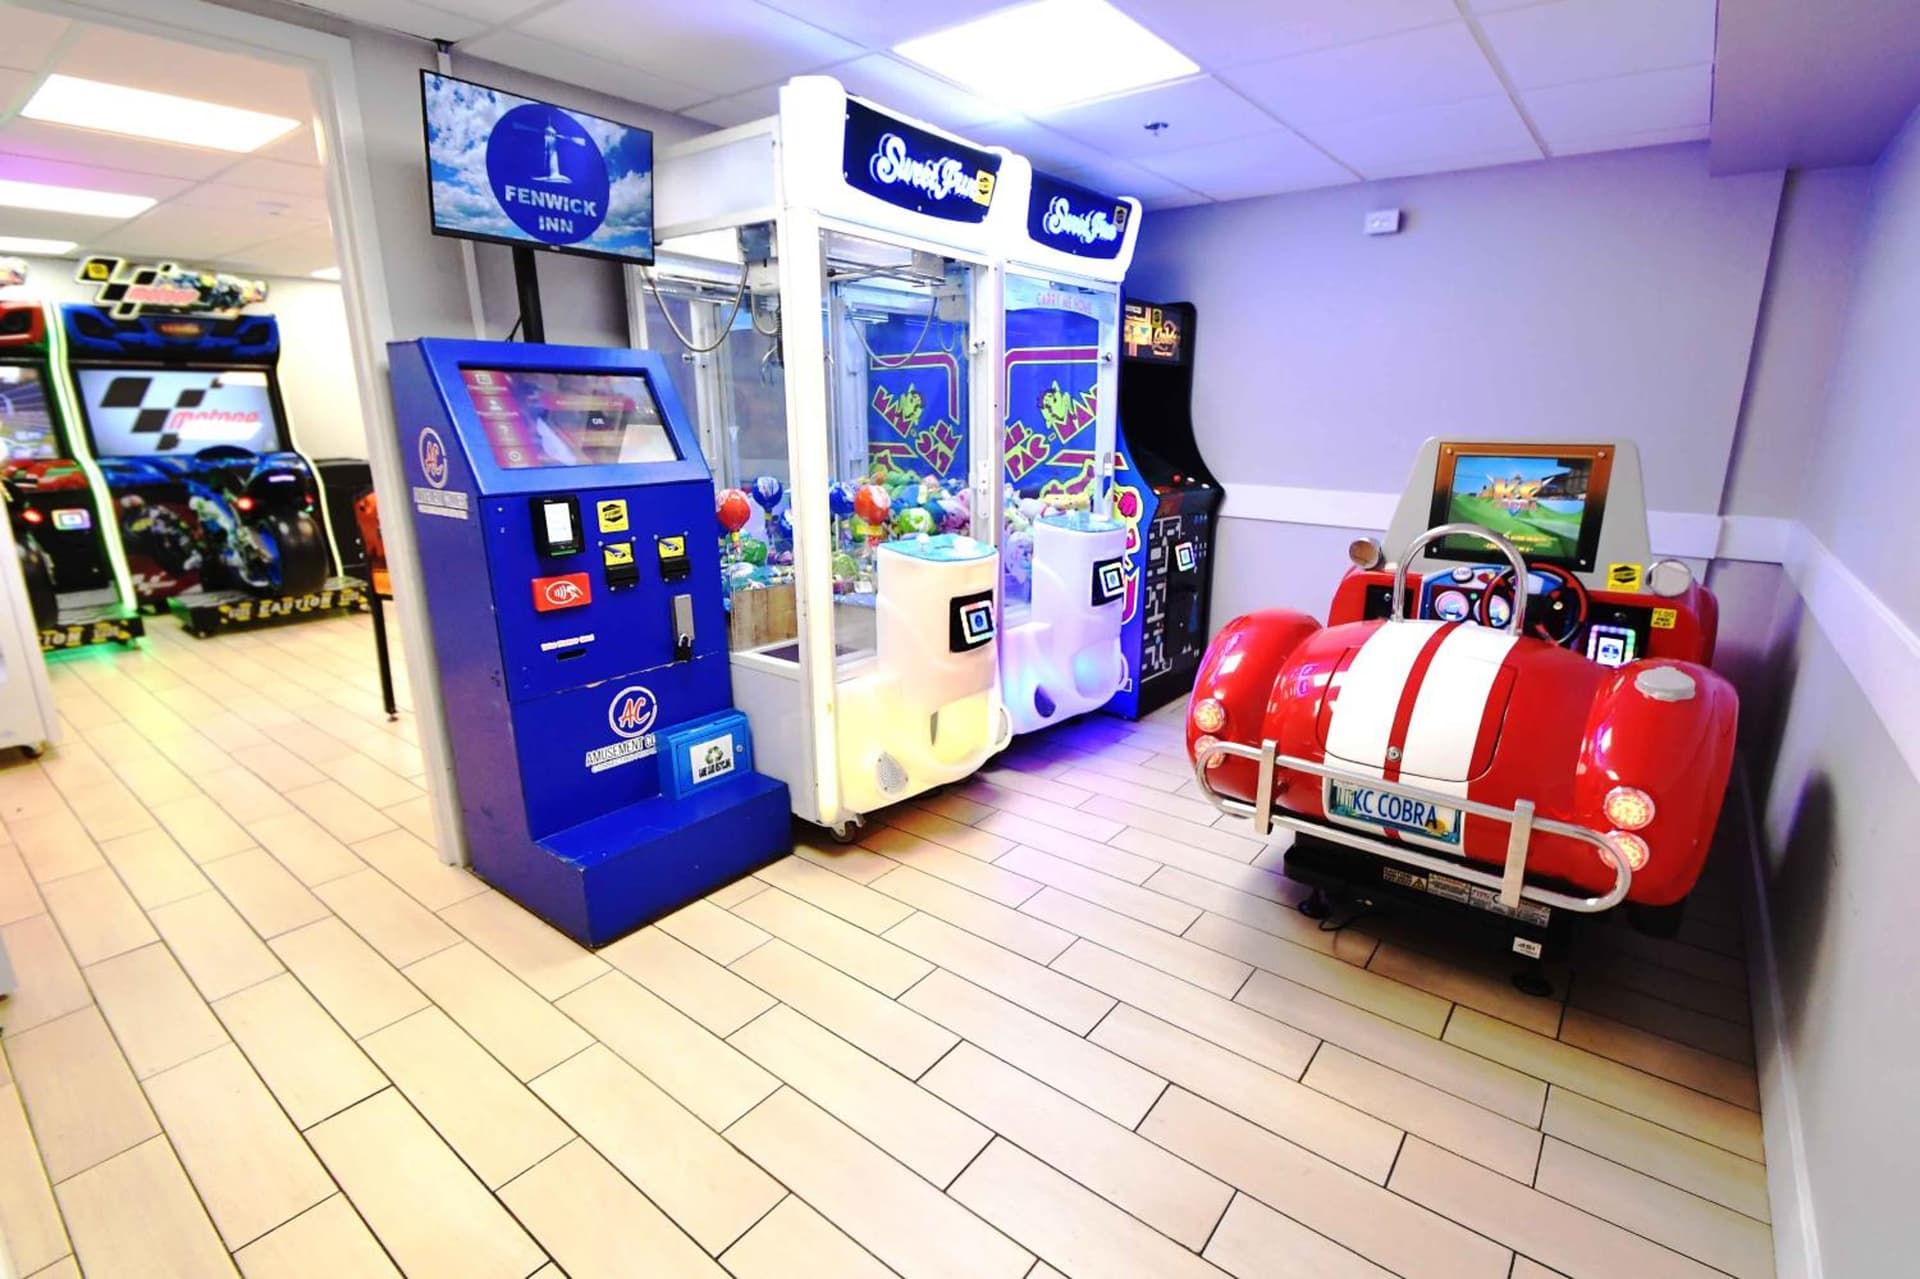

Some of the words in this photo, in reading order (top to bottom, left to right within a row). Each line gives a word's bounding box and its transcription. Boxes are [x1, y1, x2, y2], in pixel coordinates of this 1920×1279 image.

[504, 184, 597, 217] FENWICK
[538, 214, 575, 234] INN
[258, 590, 332, 617] CAUTION
[618, 697, 650, 729] AC
[586, 735, 645, 767] AMUSEMENT
[1353, 788, 1374, 814] KC
[1378, 793, 1438, 830] COBRA
